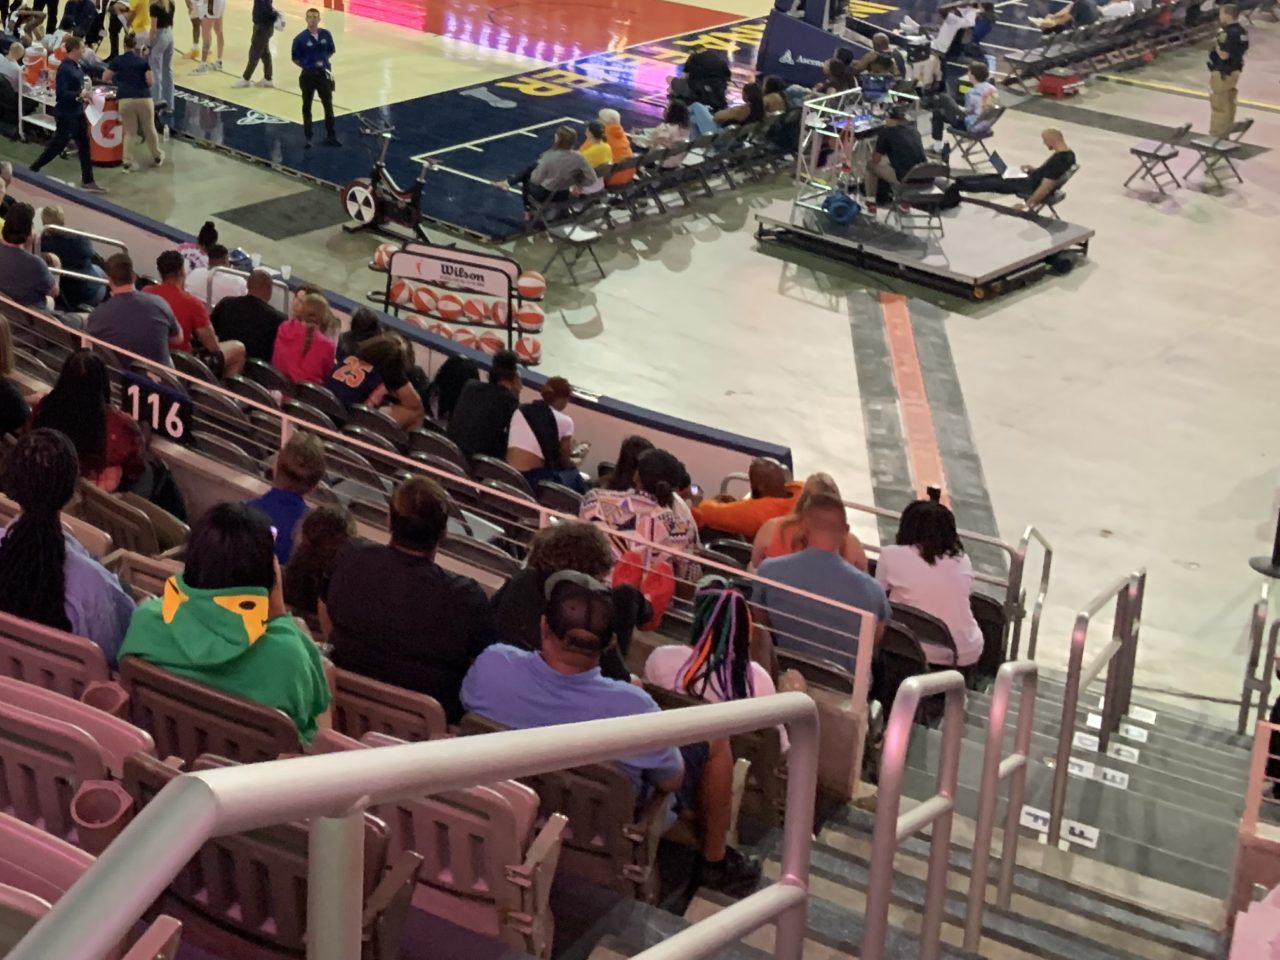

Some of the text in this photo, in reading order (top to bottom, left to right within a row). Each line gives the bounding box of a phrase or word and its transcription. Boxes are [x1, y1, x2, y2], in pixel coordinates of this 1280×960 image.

[91, 111, 123, 148] G
[440, 263, 485, 283] Wilson
[332, 355, 373, 388] 25
[128, 384, 184, 438] 116
[1025, 811, 1094, 842] F F
